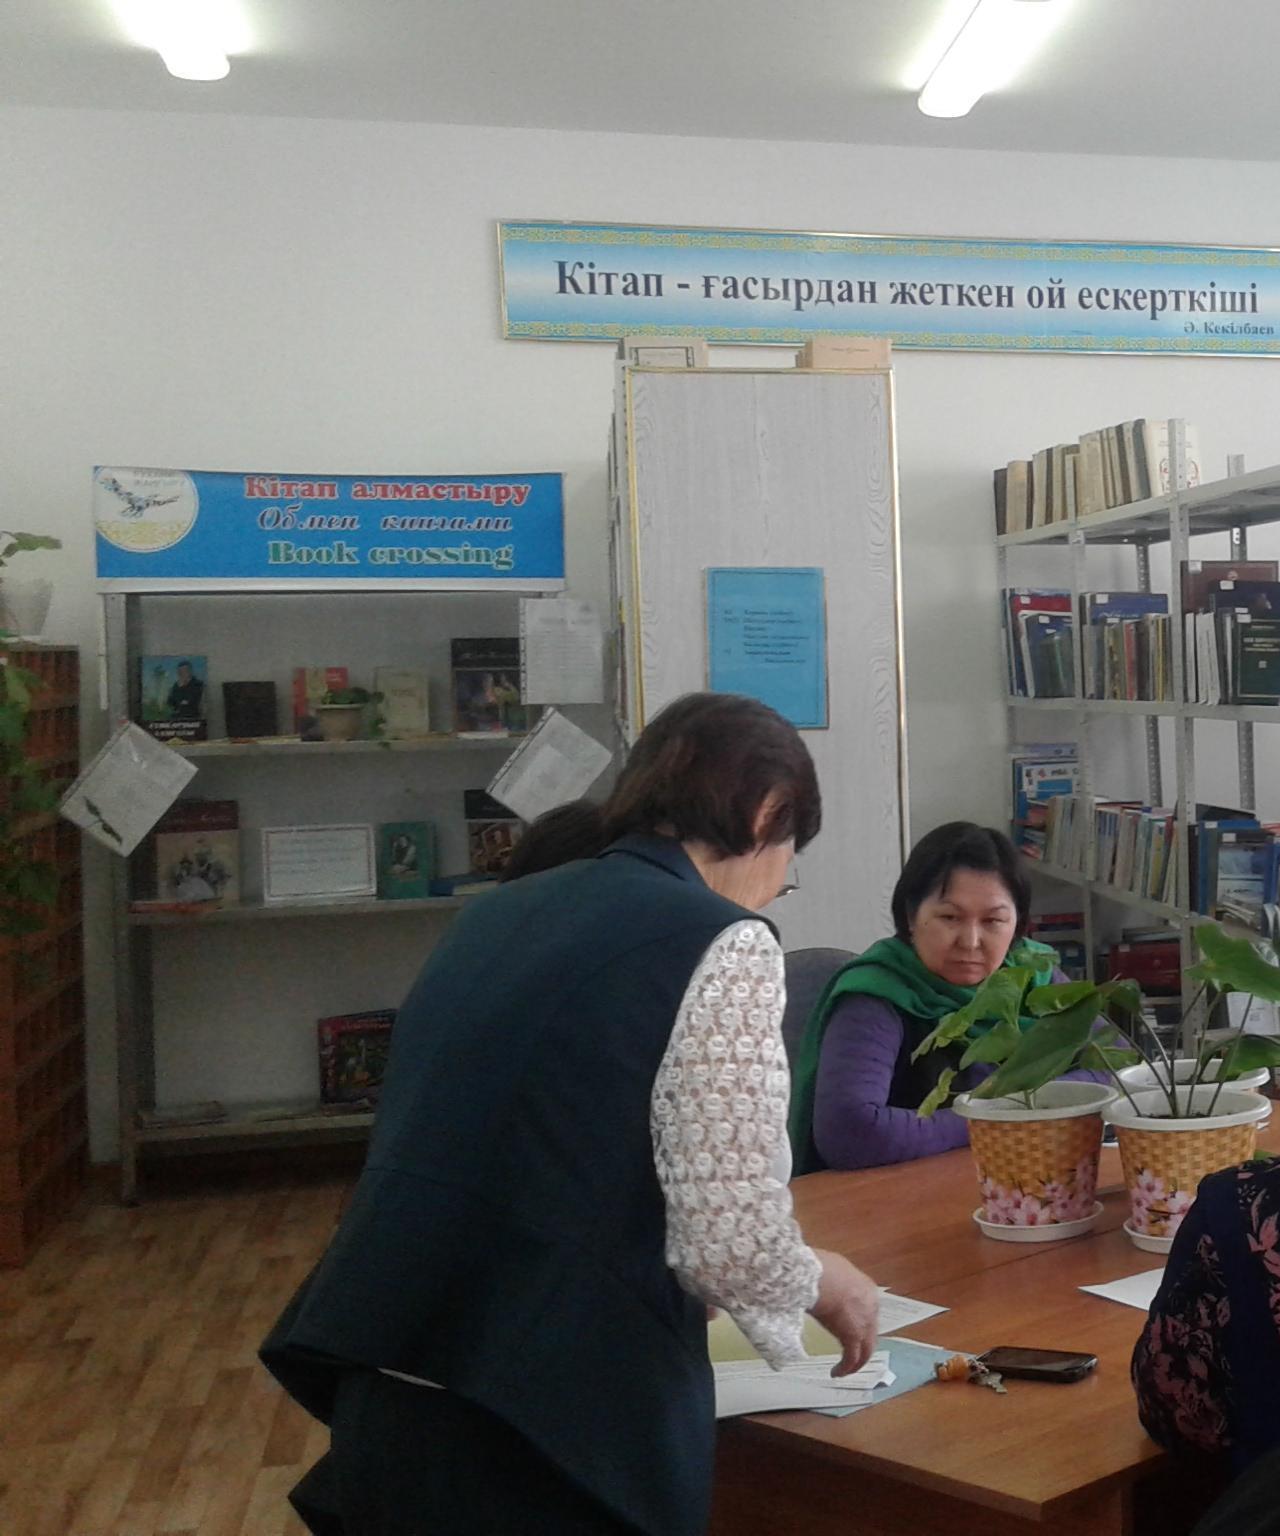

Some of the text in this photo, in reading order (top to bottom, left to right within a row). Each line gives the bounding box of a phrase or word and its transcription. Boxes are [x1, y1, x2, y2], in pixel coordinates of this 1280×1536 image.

[553, 260, 664, 297] Кітап
[702, 275, 878, 312] ғасырдан
[889, 281, 1014, 309] жеткен
[1027, 277, 1067, 309] ой
[1078, 281, 1259, 321] ескерткіші
[244, 476, 531, 506] Кітап алмастыру
[258, 504, 514, 532] Обмен книгами
[267, 540, 514, 570] Book crossing
